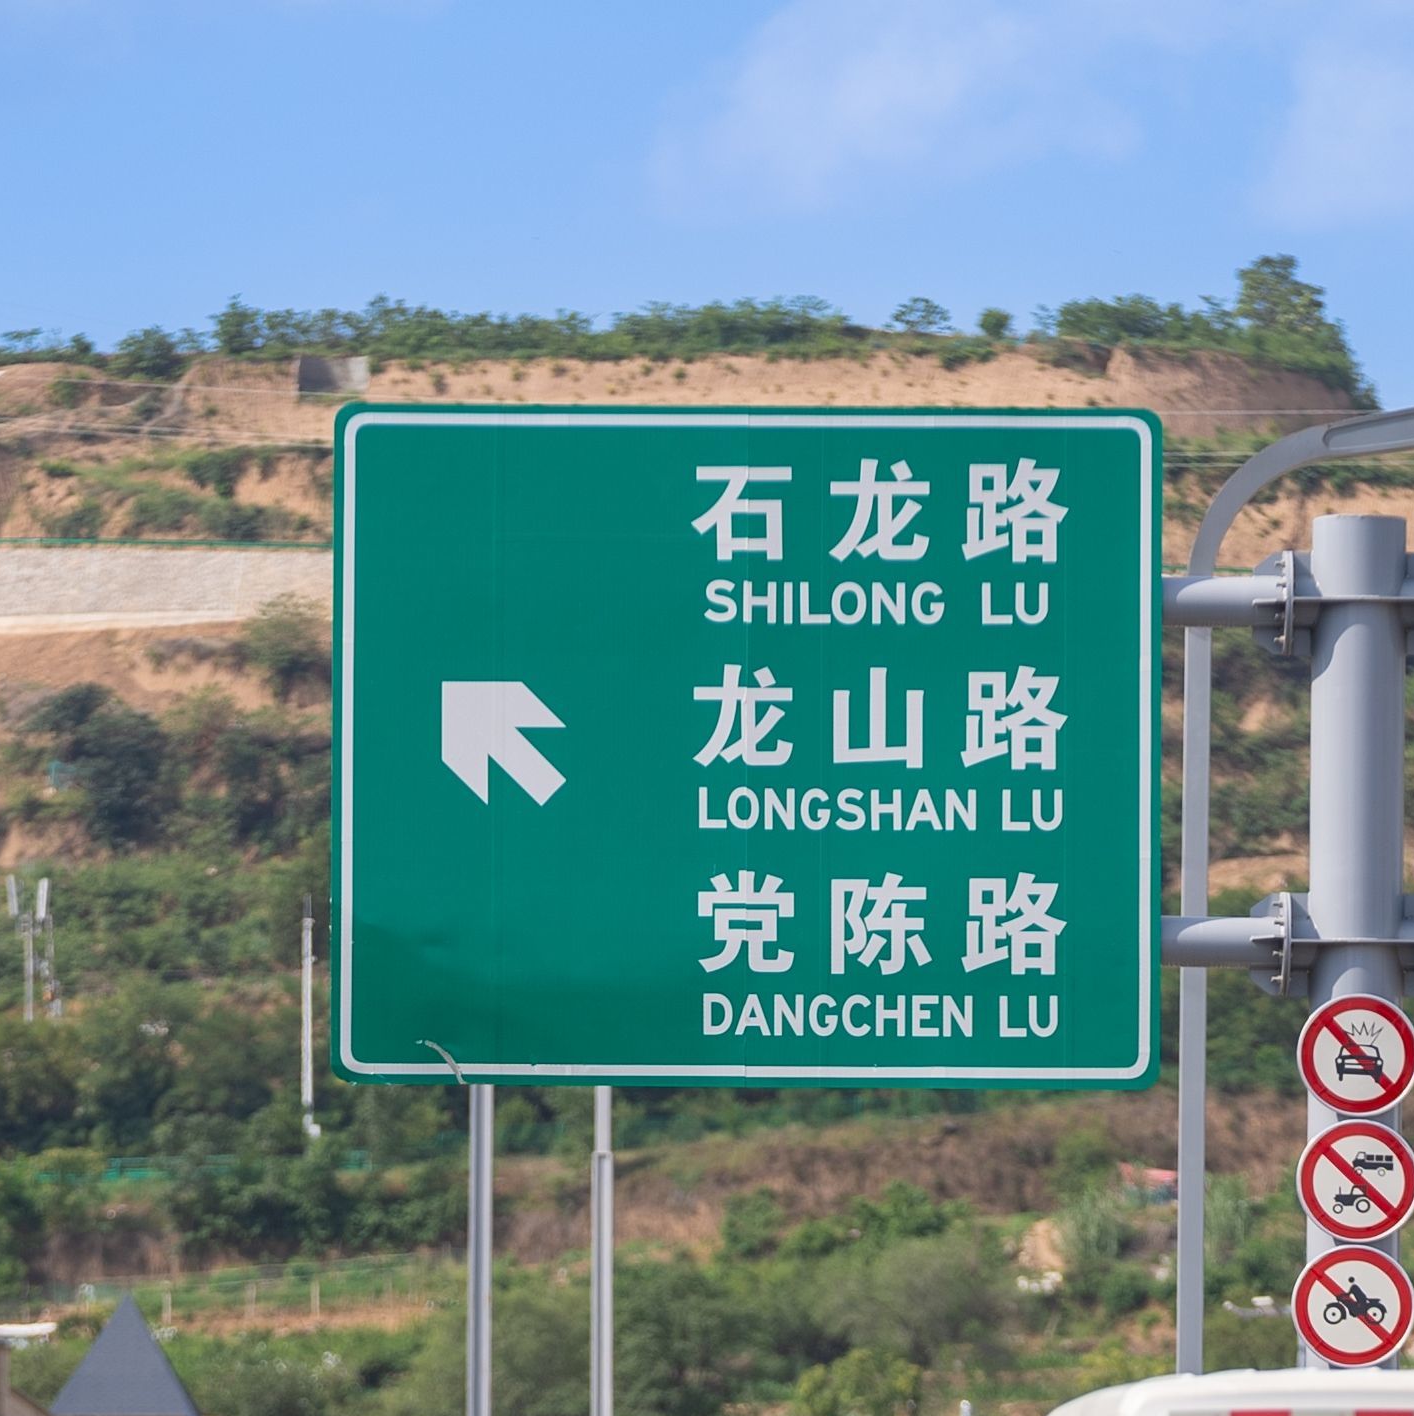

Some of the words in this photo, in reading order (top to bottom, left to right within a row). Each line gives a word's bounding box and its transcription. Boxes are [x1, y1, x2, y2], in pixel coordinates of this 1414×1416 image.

[692, 458, 1070, 564] 石龙路
[704, 580, 947, 626] SHILONG
[981, 582, 1050, 626] LU
[693, 664, 1069, 772] 龙山路
[698, 787, 978, 832] LONGSHAN
[1001, 789, 1065, 832] LU
[697, 870, 1068, 977] 党陈路
[703, 993, 975, 1039] DANGCHEN
[999, 995, 1061, 1039] LU
